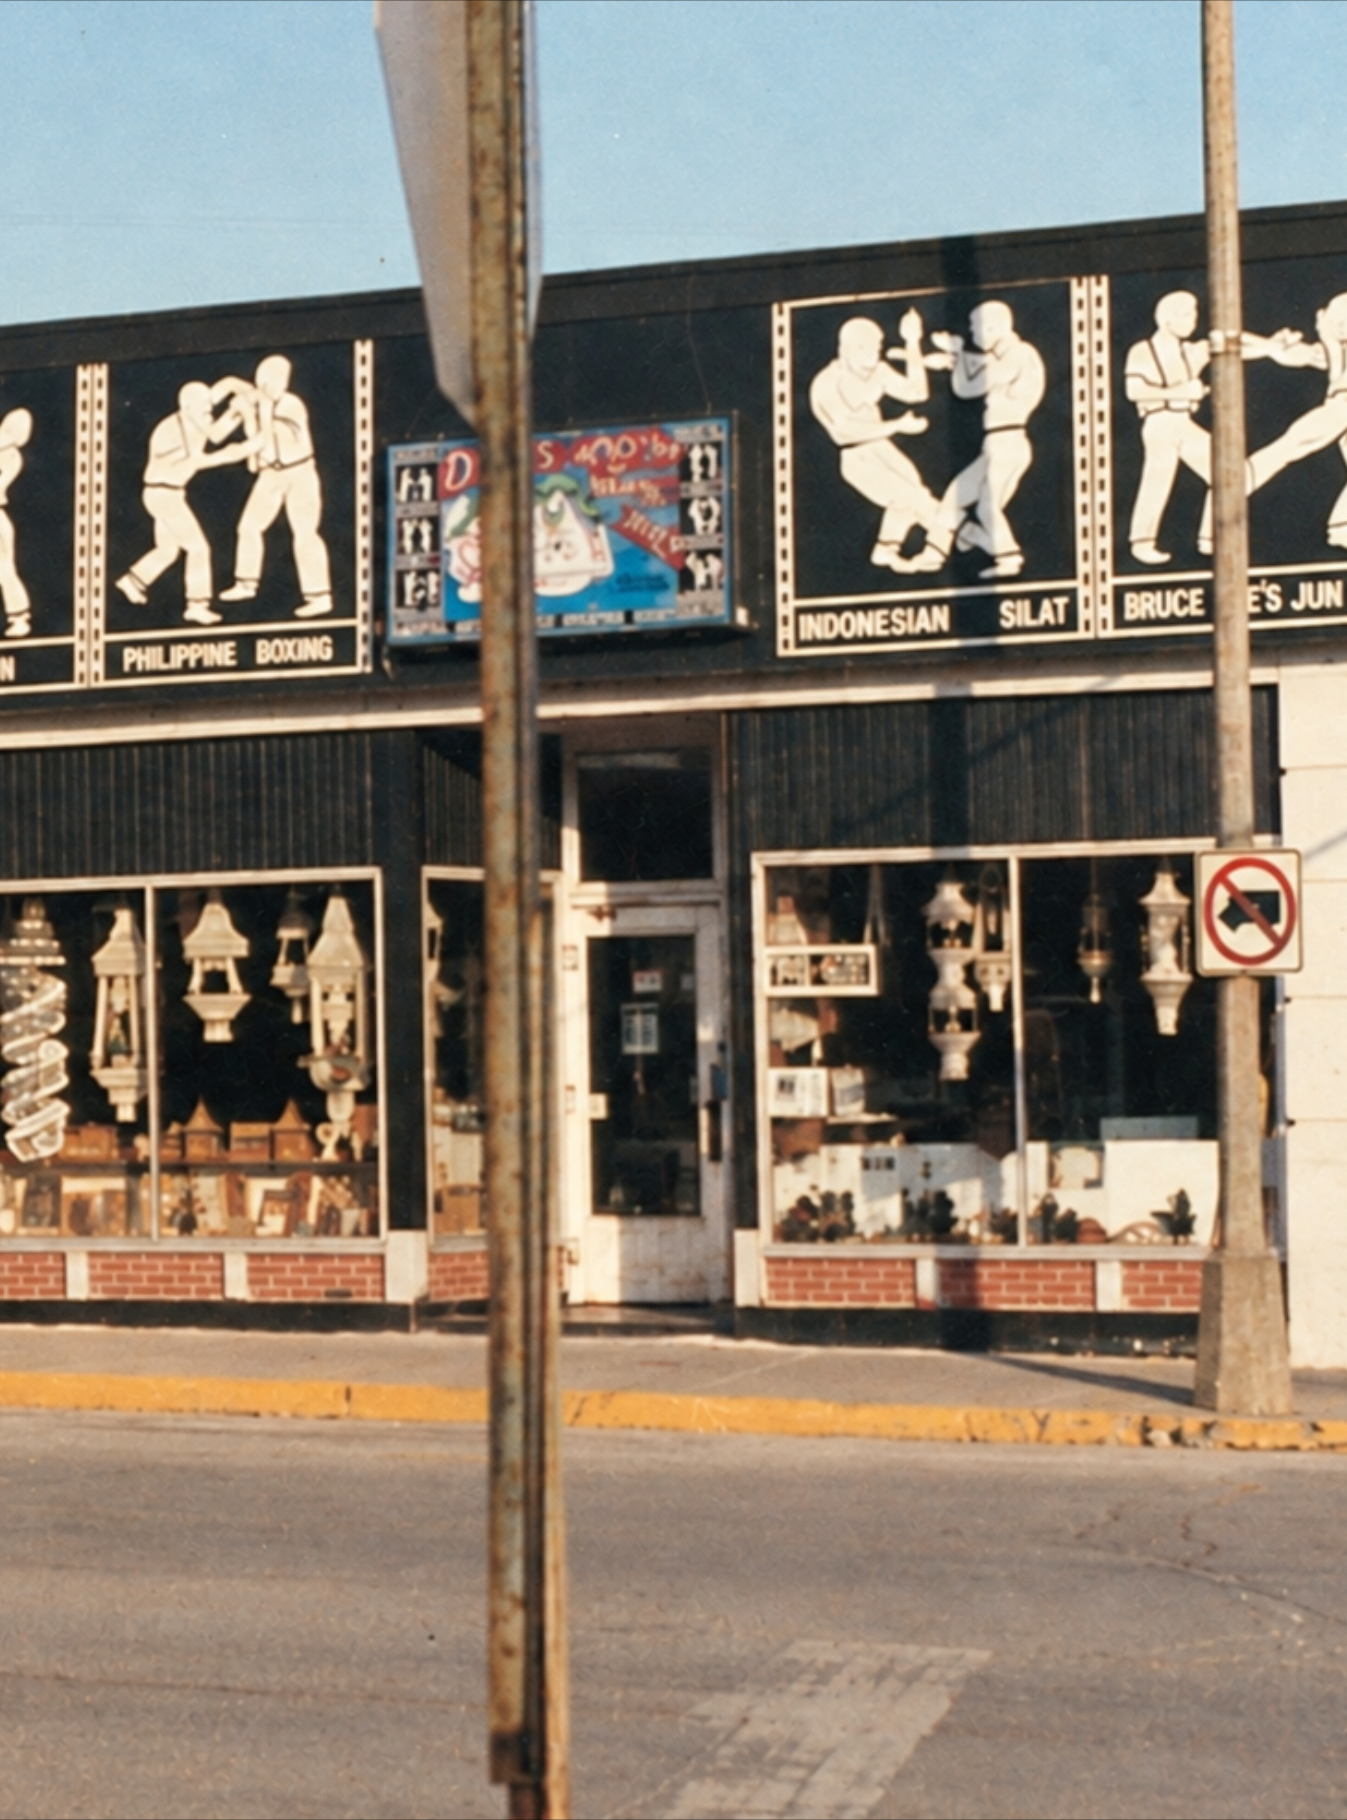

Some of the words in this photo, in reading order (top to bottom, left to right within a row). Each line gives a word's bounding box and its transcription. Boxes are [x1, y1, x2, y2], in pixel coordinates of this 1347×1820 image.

[799, 605, 950, 641] INDONESIAN
[1000, 596, 1069, 628] SILAT
[1124, 588, 1204, 620] BRUCE
[1248, 579, 1282, 614] E'S
[1290, 580, 1343, 611] JUN
[123, 640, 237, 672] PHILIPPINE
[256, 636, 333, 664] BOXING
